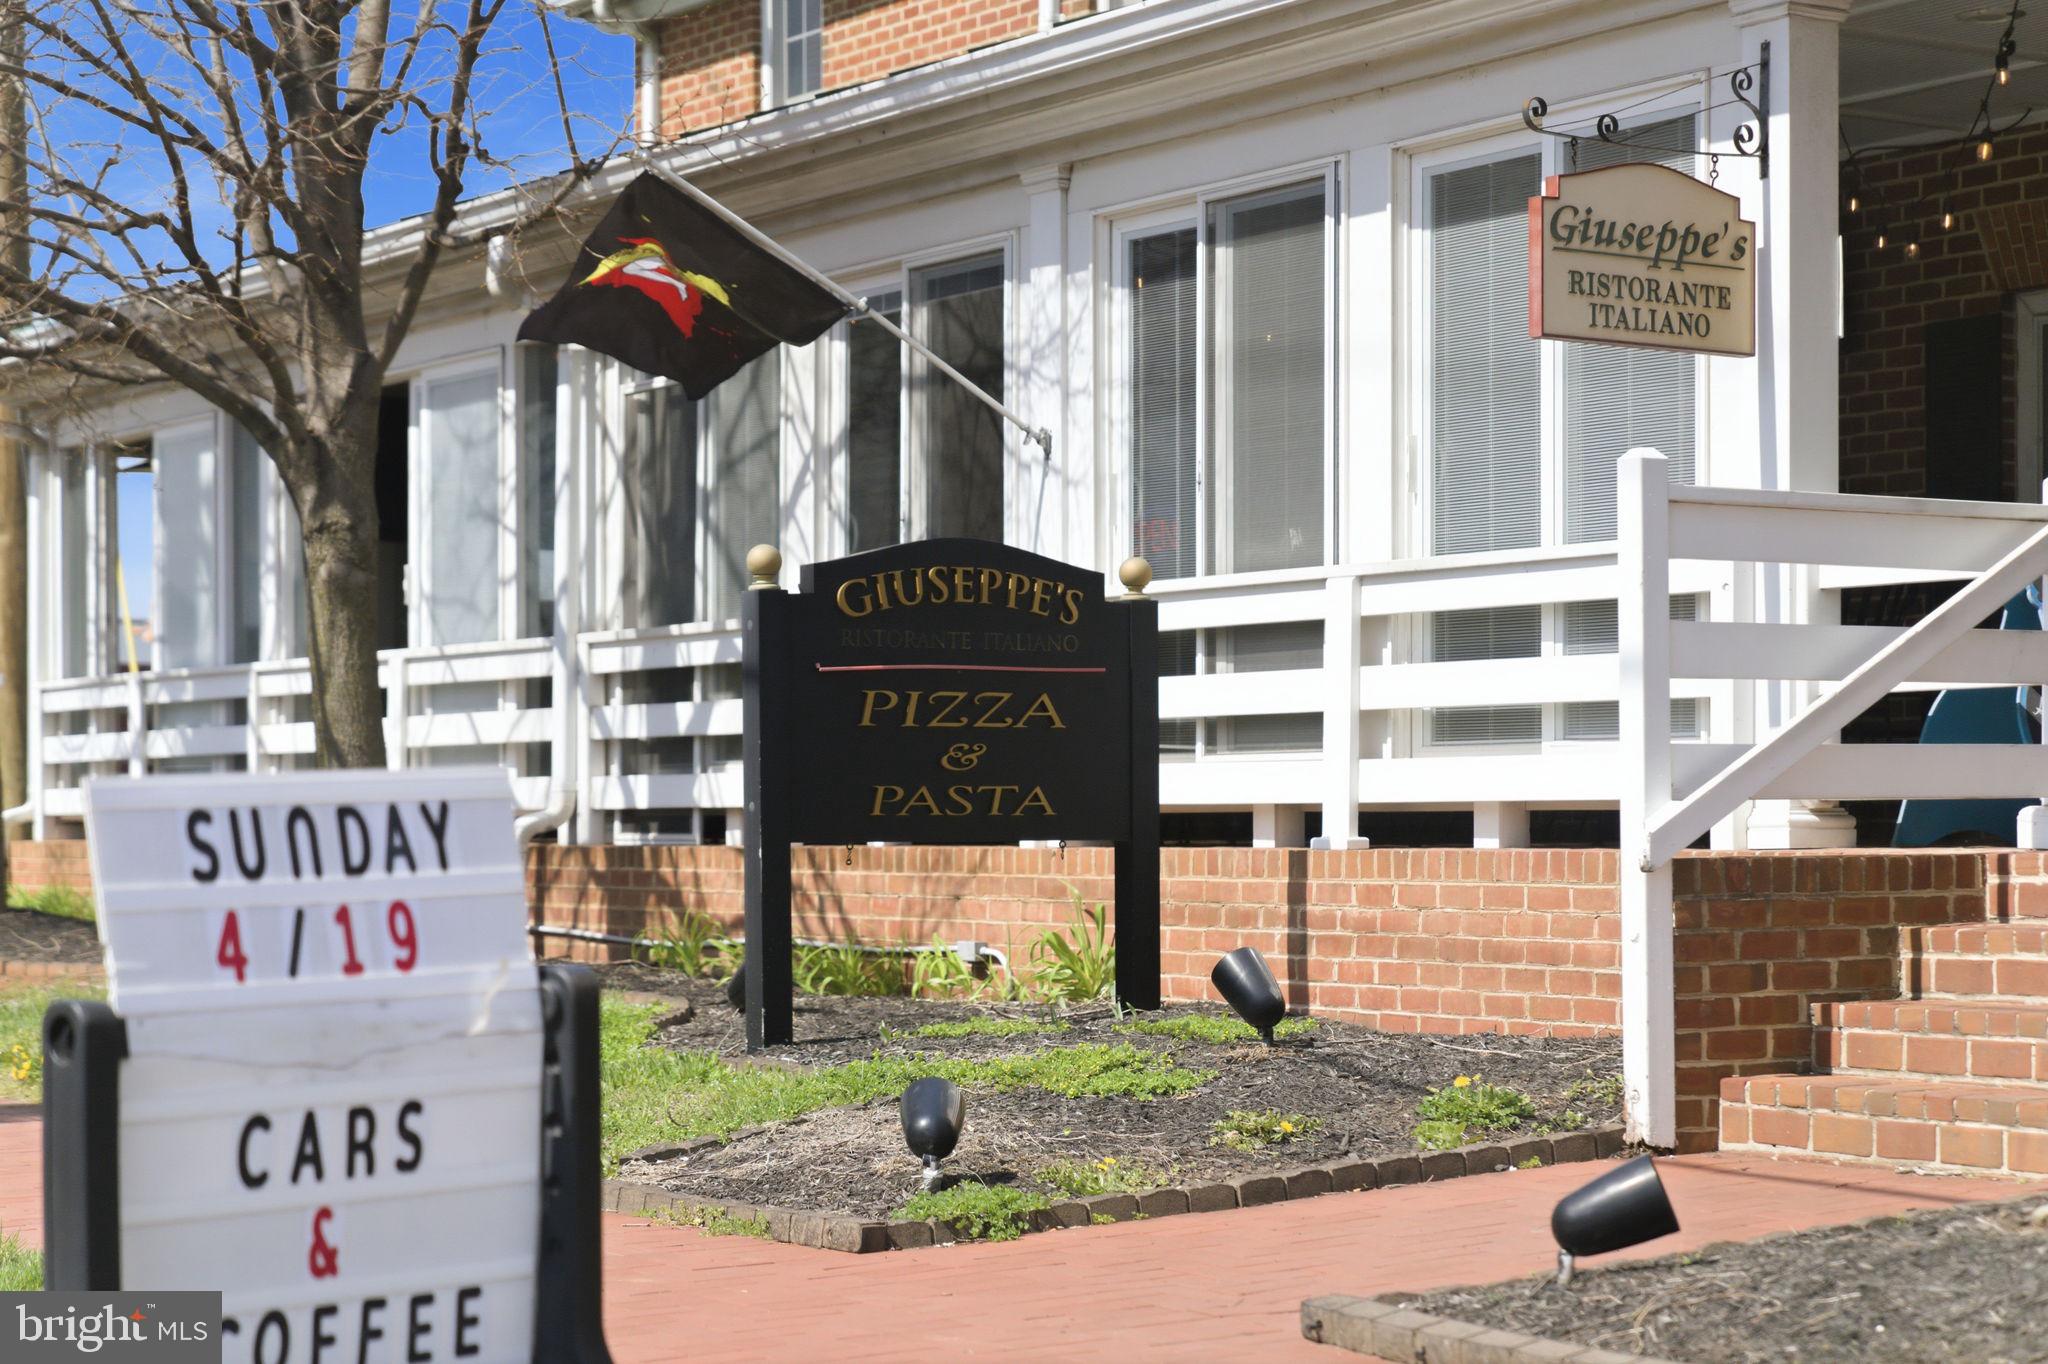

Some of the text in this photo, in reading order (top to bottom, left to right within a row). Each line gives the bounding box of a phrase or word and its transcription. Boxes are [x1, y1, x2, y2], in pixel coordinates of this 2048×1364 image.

[1549, 204, 1748, 272] Giuseppe's
[1567, 269, 1732, 310] RISTORANTE
[1588, 302, 1711, 338] ITALIANO
[836, 565, 1085, 625] GIUSEPPE'S
[840, 628, 1080, 653] RISTORANTE ITALIANO
[857, 689, 1067, 729] PIZZA
[940, 743, 988, 772] &
[868, 785, 1058, 817] PASTA
[186, 800, 449, 883] SUNDAY
[236, 1099, 425, 1190] CARS
[308, 1206, 339, 1279] &
[222, 1286, 482, 1364] OFFEE
